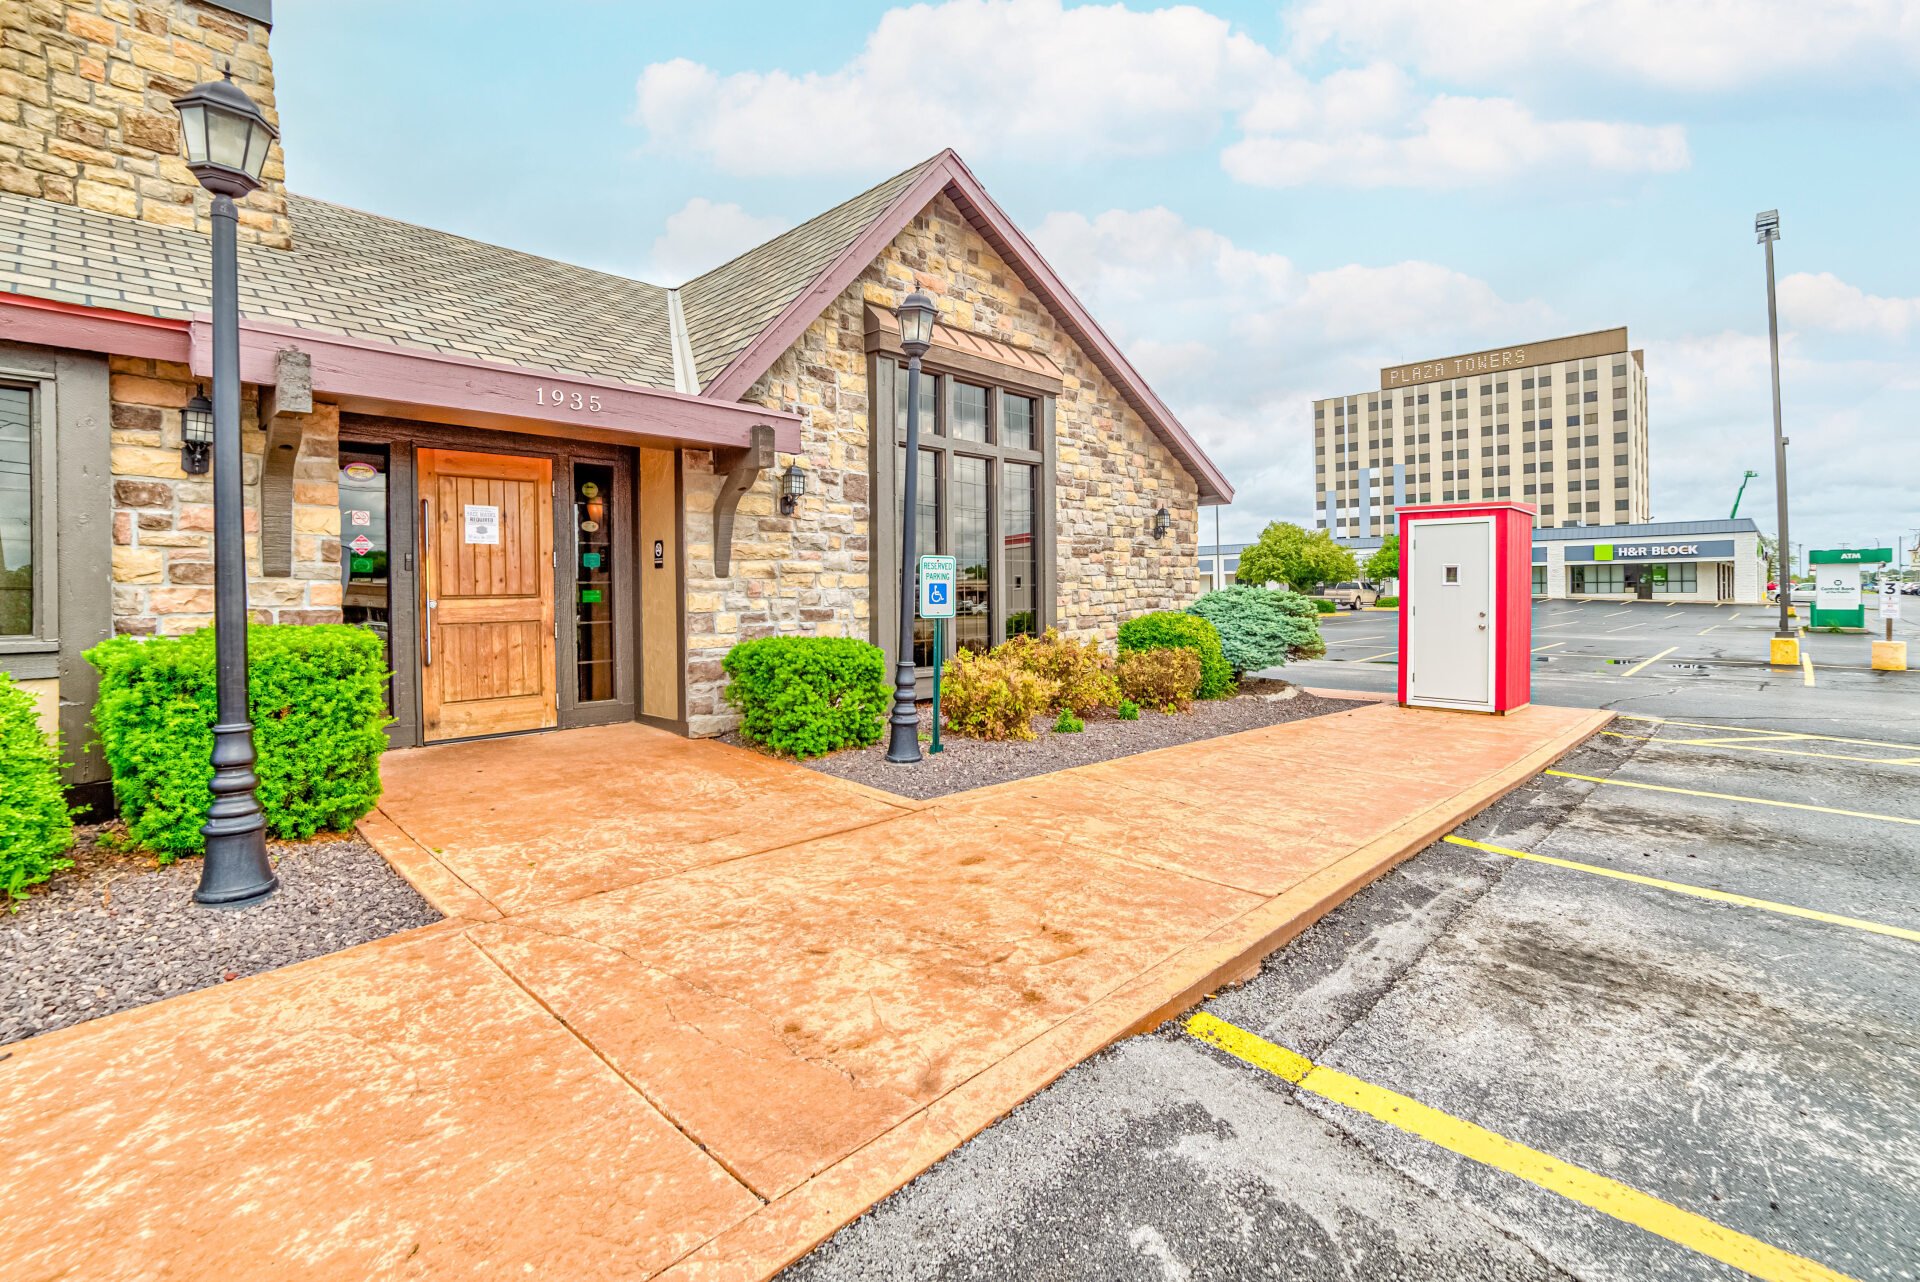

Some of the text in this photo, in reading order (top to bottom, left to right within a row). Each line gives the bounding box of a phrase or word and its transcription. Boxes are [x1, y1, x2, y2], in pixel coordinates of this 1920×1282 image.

[1390, 349, 1525, 384] PLAZA TOWERS
[536, 387, 602, 412] 1935
[1618, 545, 1698, 557] H&R BLOCK
[923, 562, 952, 571] RESERVED
[925, 572, 950, 580] PARKING
[1884, 583, 1896, 595] 3
